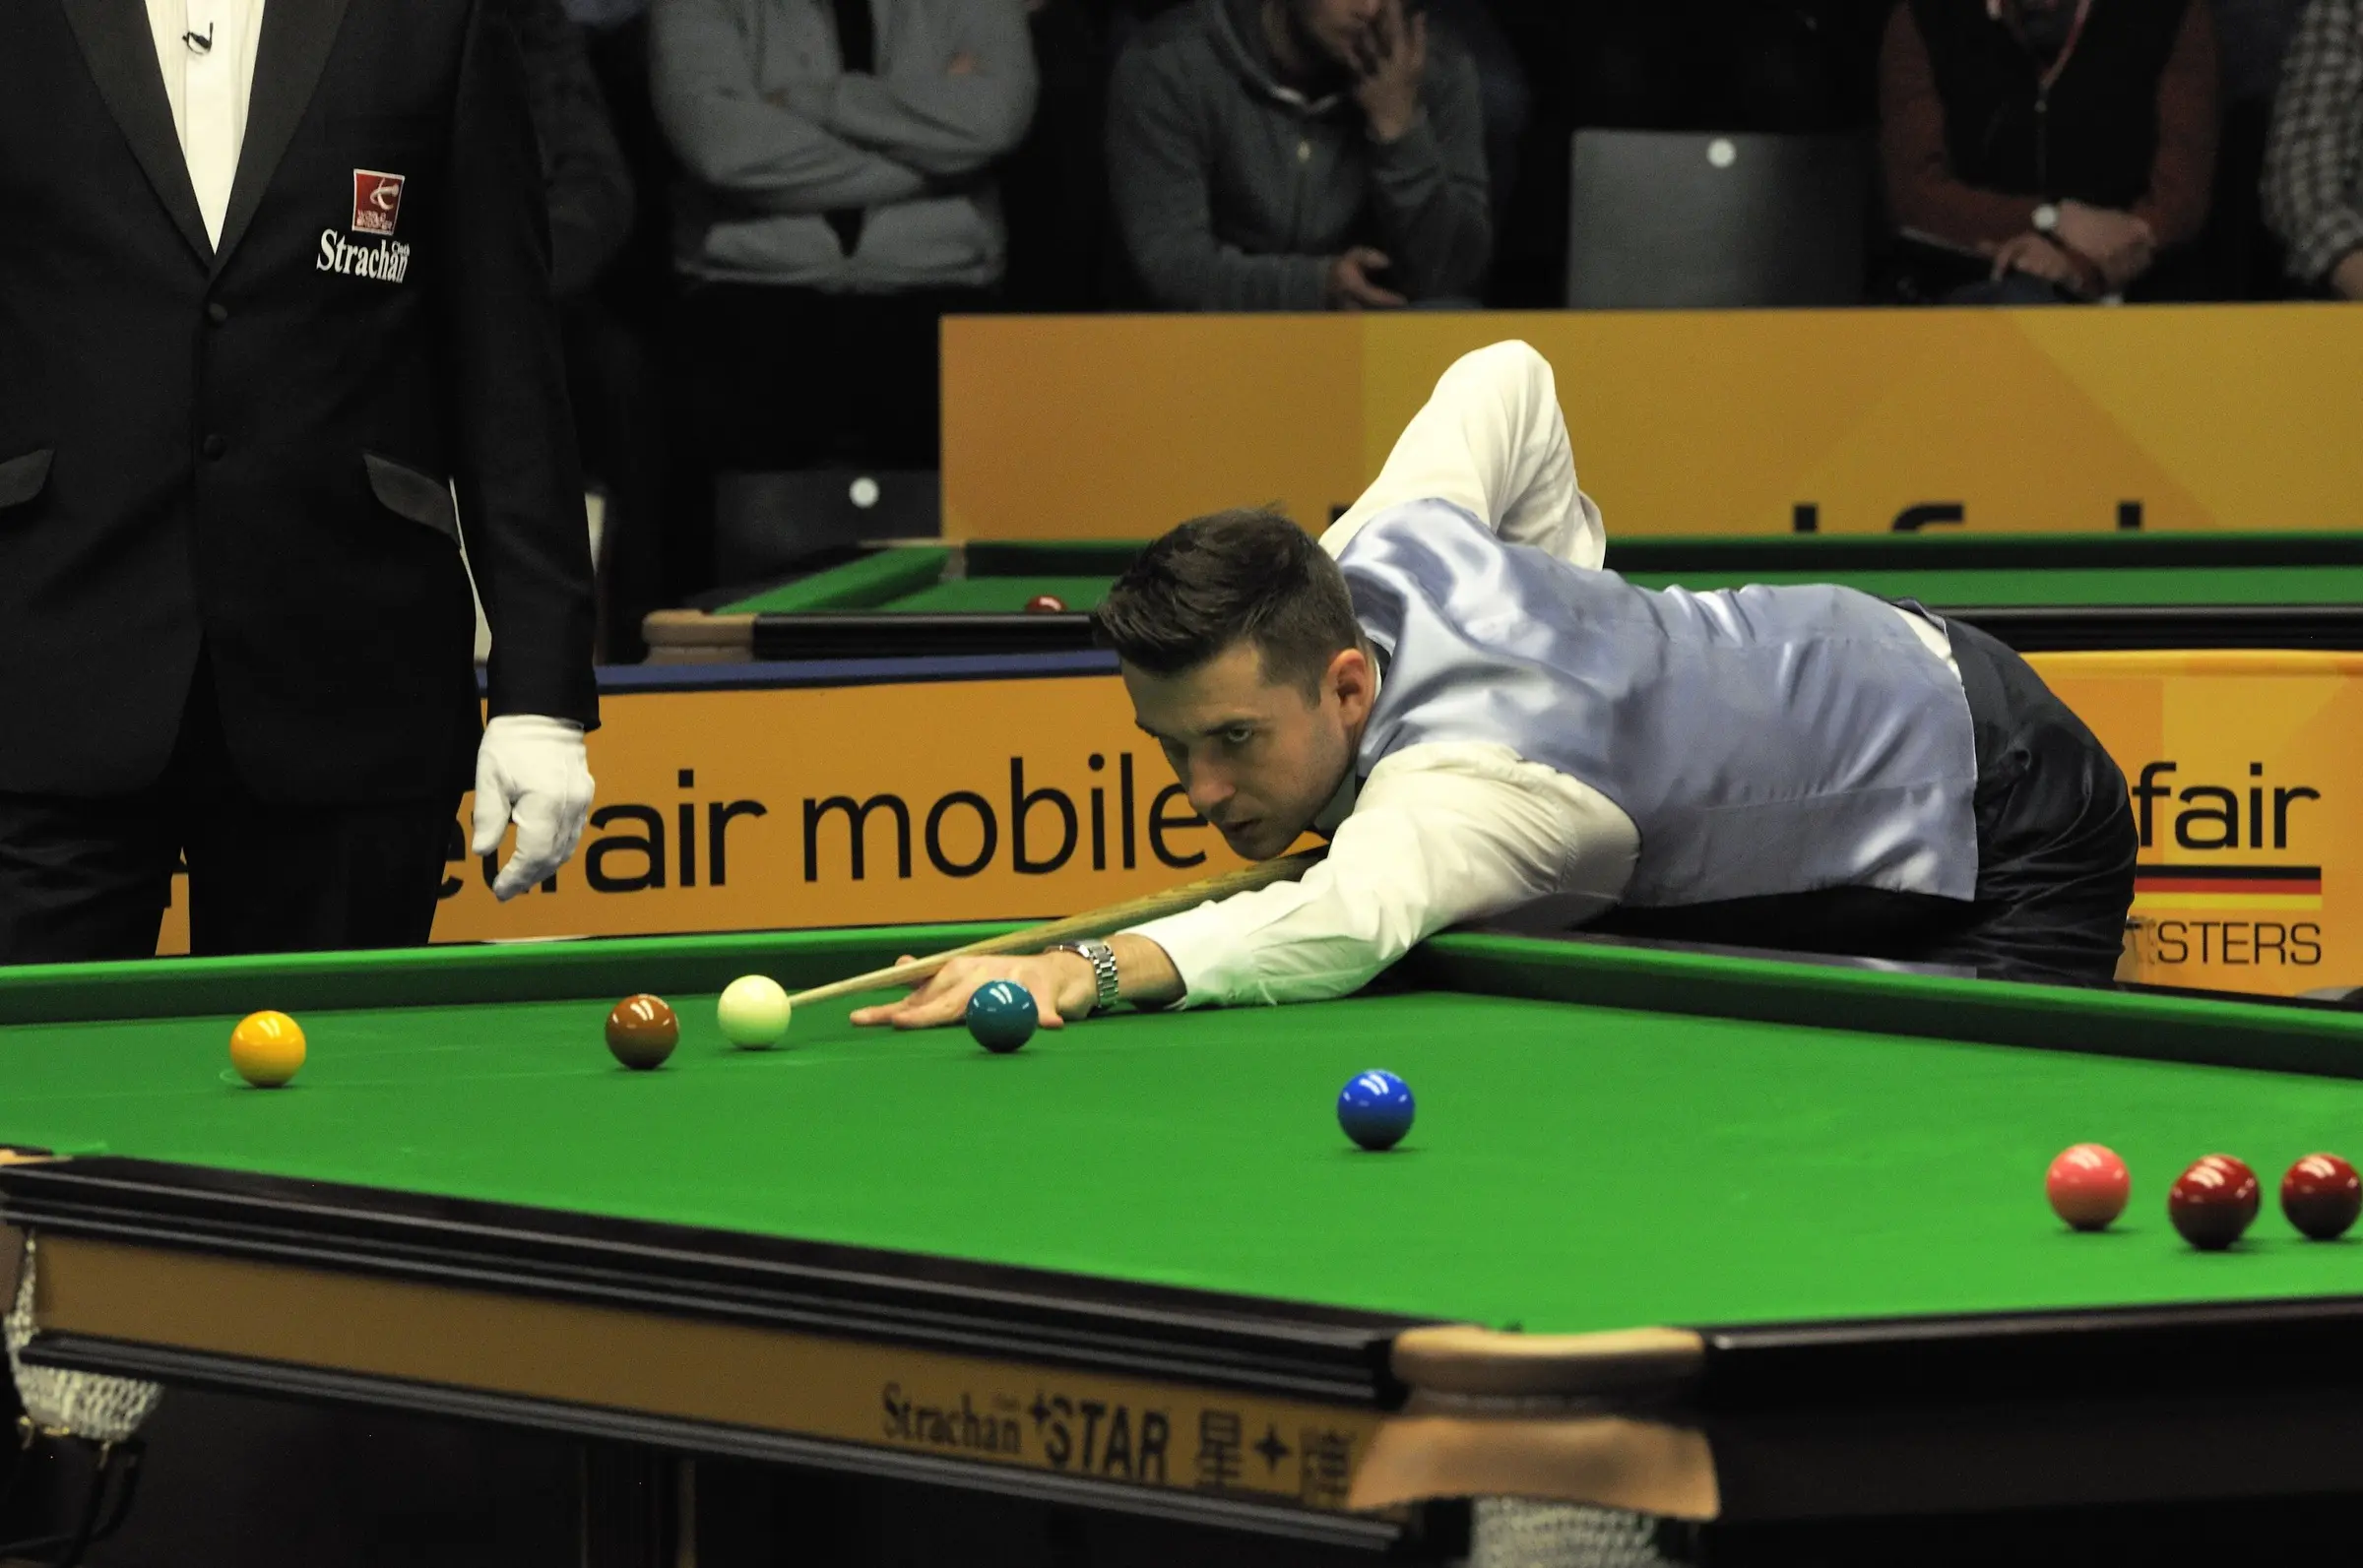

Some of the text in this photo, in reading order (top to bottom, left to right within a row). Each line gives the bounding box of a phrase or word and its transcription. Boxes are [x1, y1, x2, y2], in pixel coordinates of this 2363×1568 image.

[316, 227, 409, 283] Strachan
[801, 751, 1209, 882] mobile
[2139, 918, 2323, 966] STERS
[881, 1381, 1171, 1483] Strachan STAR
